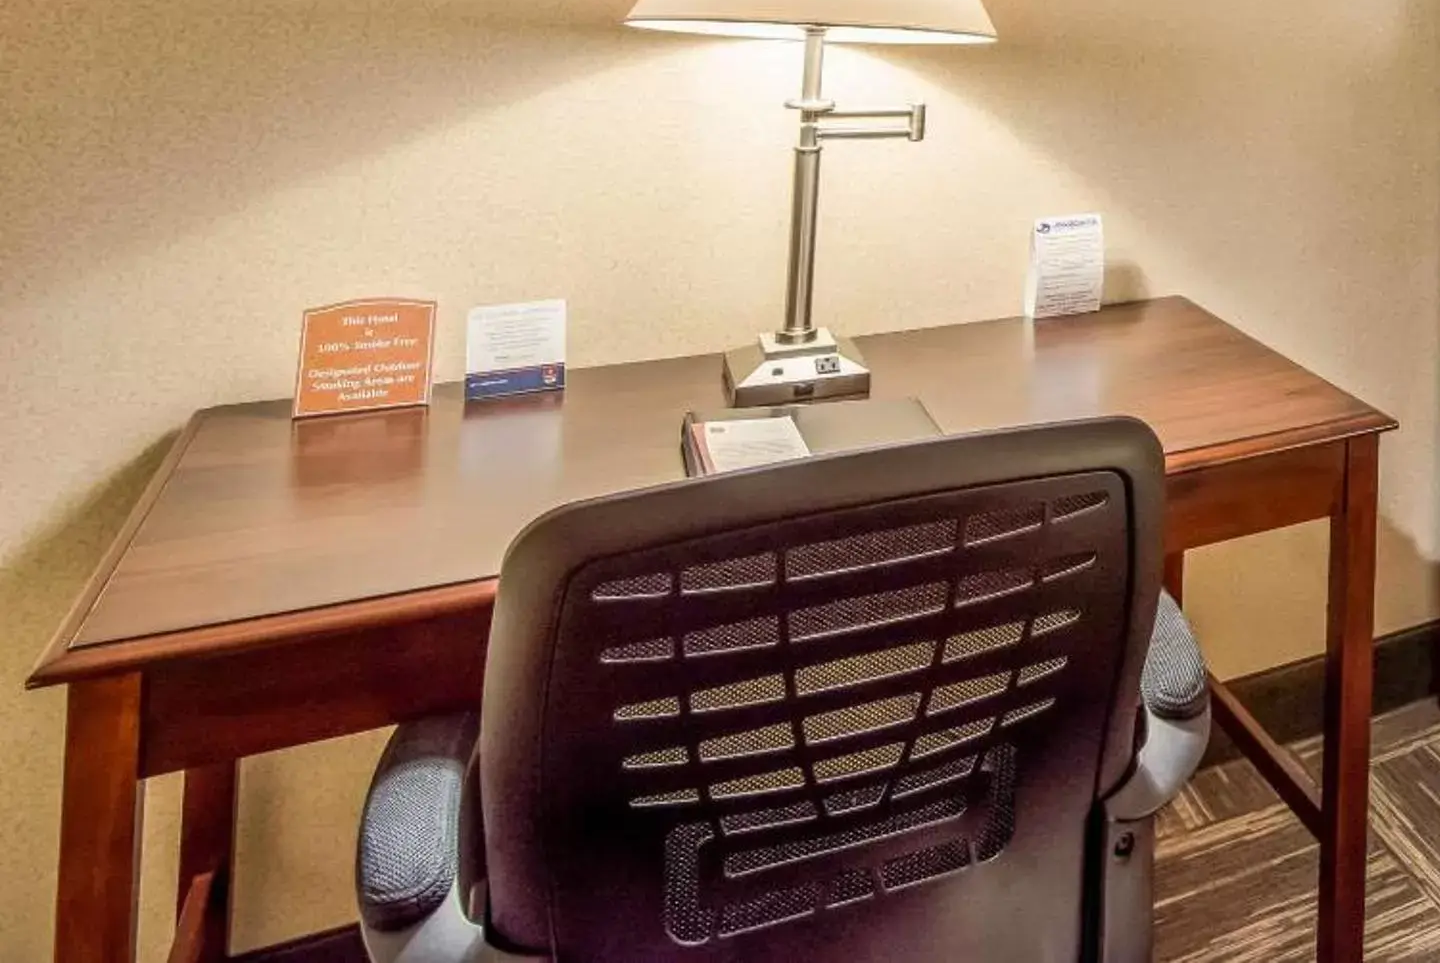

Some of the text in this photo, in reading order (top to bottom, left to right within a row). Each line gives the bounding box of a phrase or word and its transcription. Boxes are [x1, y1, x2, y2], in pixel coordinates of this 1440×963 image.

[367, 313, 399, 325] Hotel
[318, 342, 350, 353] 100%
[311, 379, 361, 391] Smoking
[338, 389, 389, 400] Available
